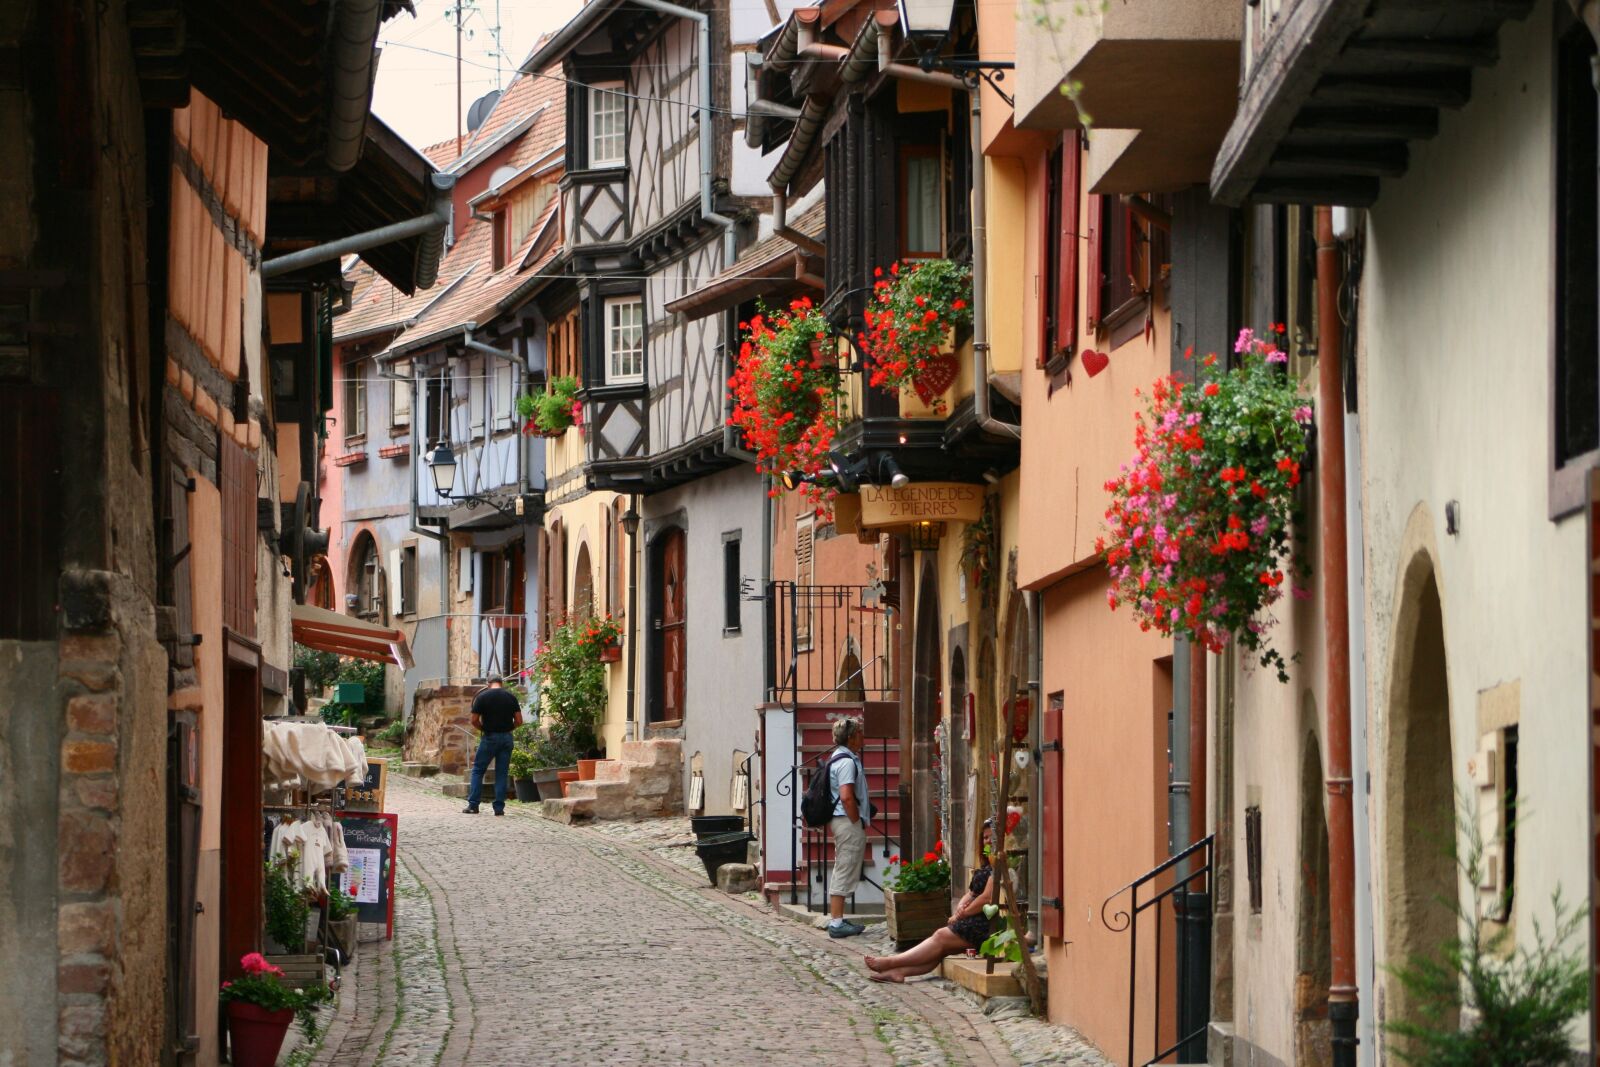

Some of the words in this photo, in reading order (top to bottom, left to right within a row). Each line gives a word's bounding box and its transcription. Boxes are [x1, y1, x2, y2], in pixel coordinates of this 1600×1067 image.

[867, 488, 884, 502] LA
[949, 487, 976, 501] DES
[890, 503, 898, 516] 2
[902, 502, 958, 515] PIERRES
